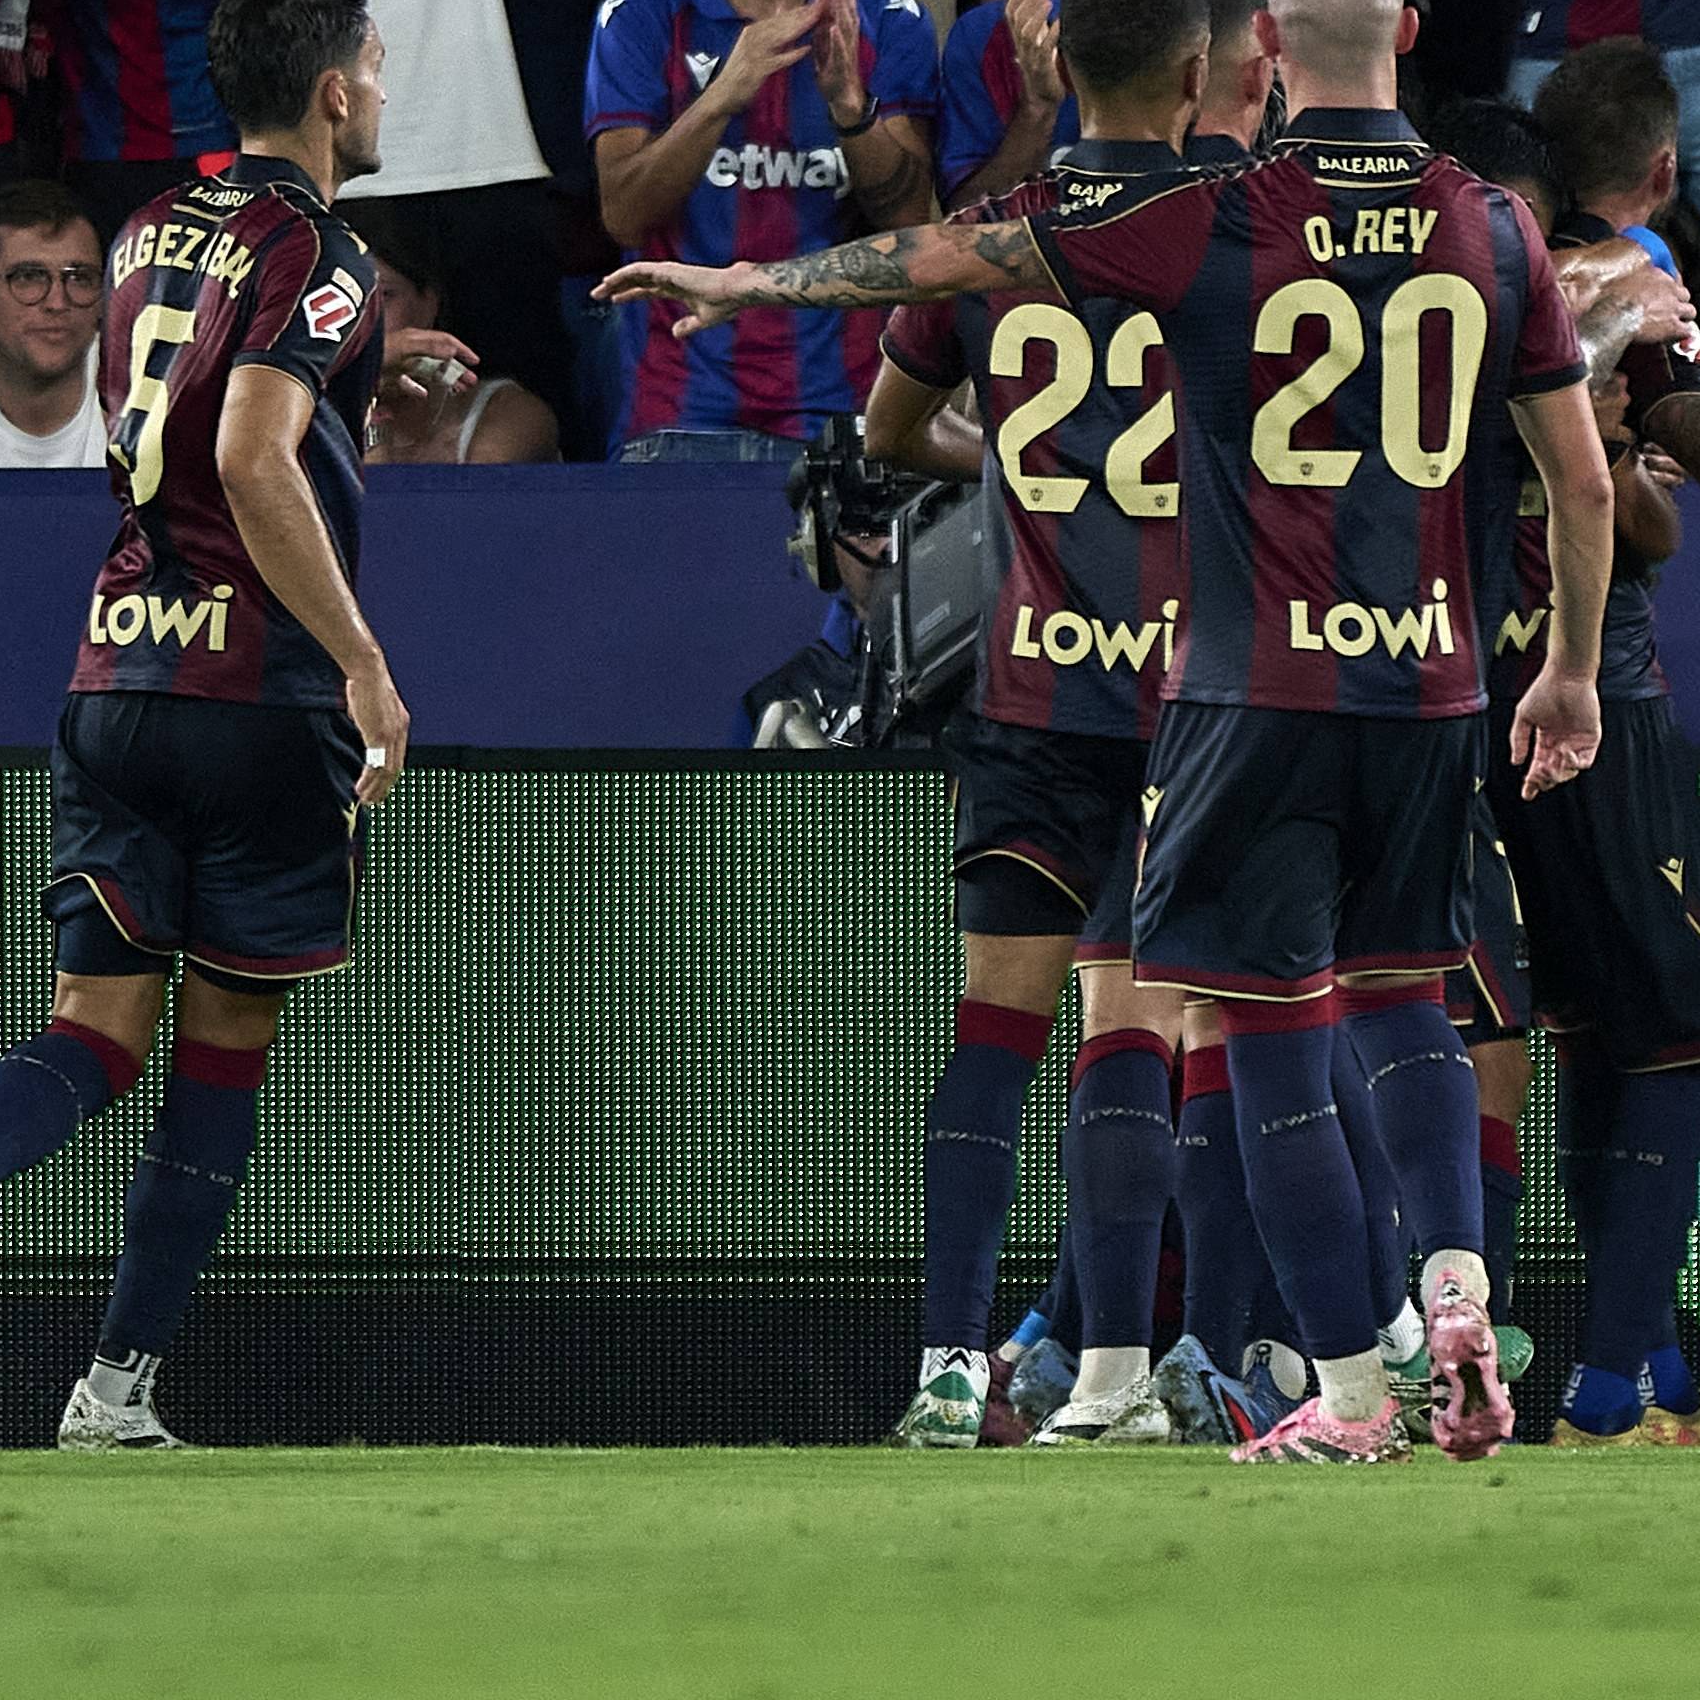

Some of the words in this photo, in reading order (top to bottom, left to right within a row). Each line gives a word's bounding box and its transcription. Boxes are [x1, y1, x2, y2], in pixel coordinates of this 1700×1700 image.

[706, 144, 851, 201] etway
[1352, 206, 1438, 255] REY
[108, 303, 197, 508] 5
[988, 301, 1180, 518] 22
[1250, 272, 1489, 490] 20
